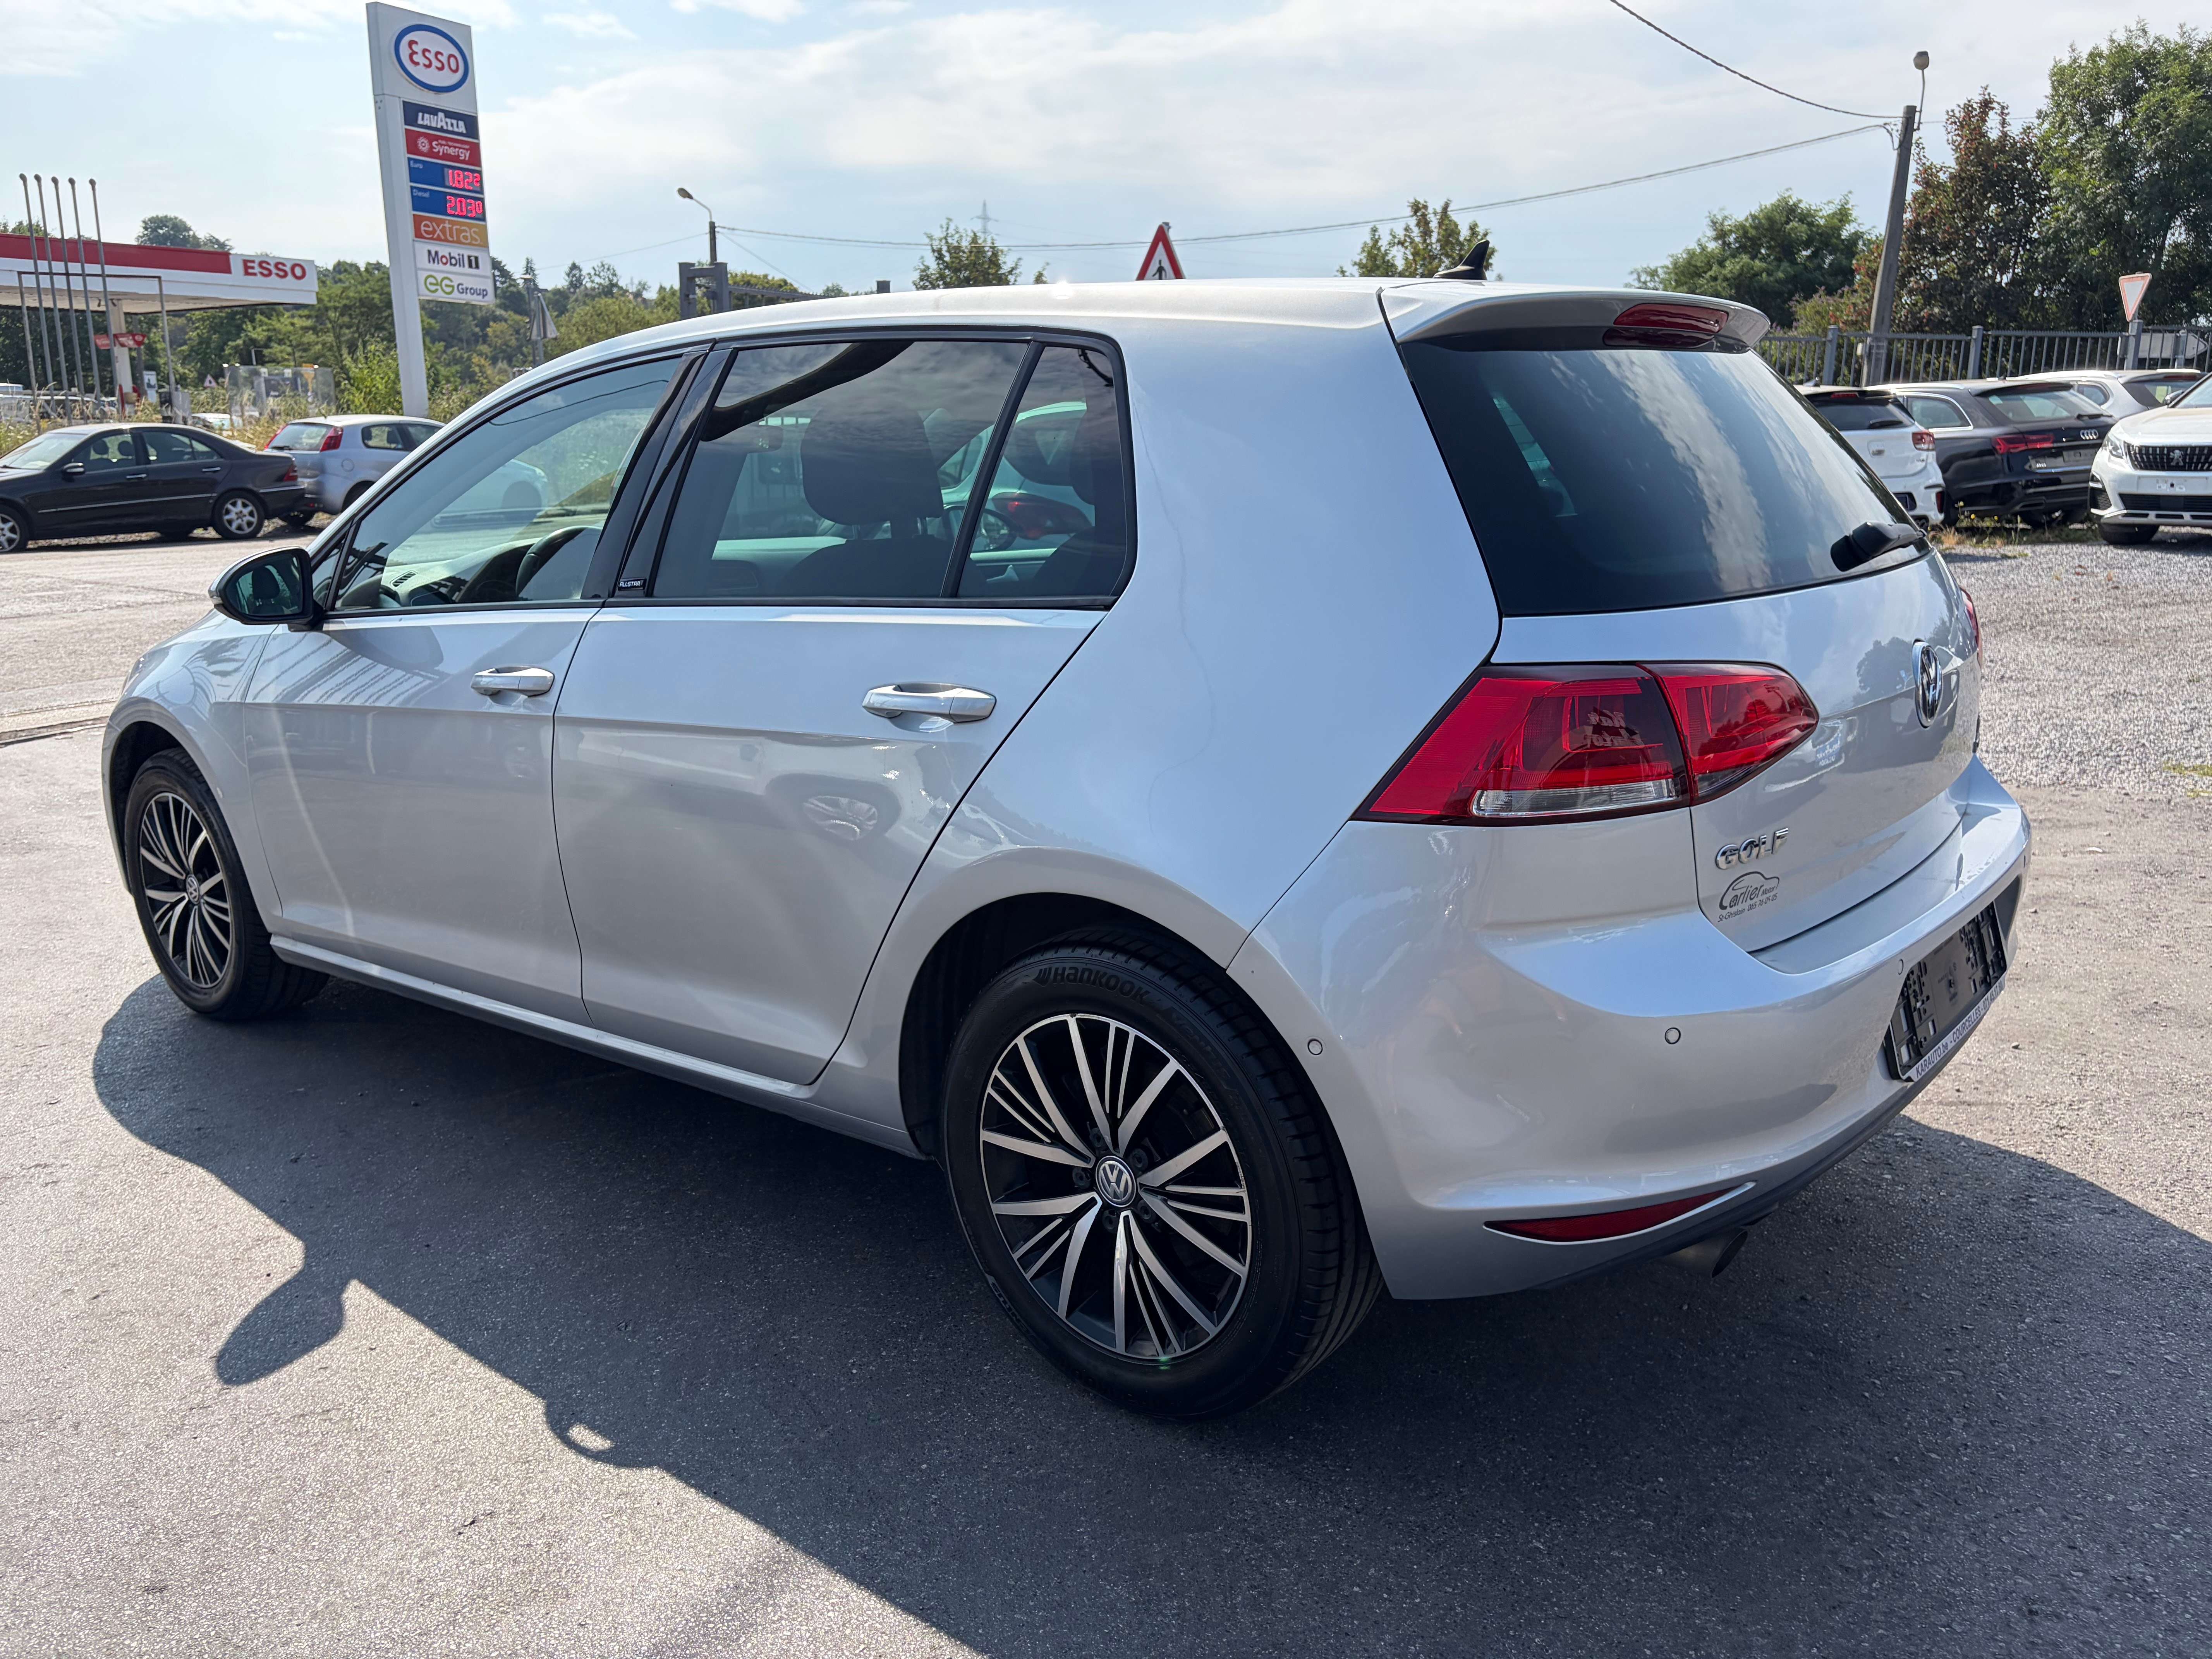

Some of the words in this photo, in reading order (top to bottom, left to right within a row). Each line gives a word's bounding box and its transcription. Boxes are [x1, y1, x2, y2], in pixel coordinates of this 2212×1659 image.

[417, 112, 466, 133] LAVAZZA
[432, 141, 470, 160] Synergy
[413, 189, 430, 198] Diesel
[427, 249, 465, 268] Mobil
[468, 256, 479, 269] 1
[243, 259, 306, 280] ESSO
[457, 283, 488, 299] Group
[1715, 828, 1788, 869] GOLF
[1719, 878, 1764, 910] Carlier
[1717, 908, 1745, 922] St-Ghislain
[1916, 1042, 1948, 1078] KARAUTO.be
[1953, 1006, 1981, 1042] COURCELLES
